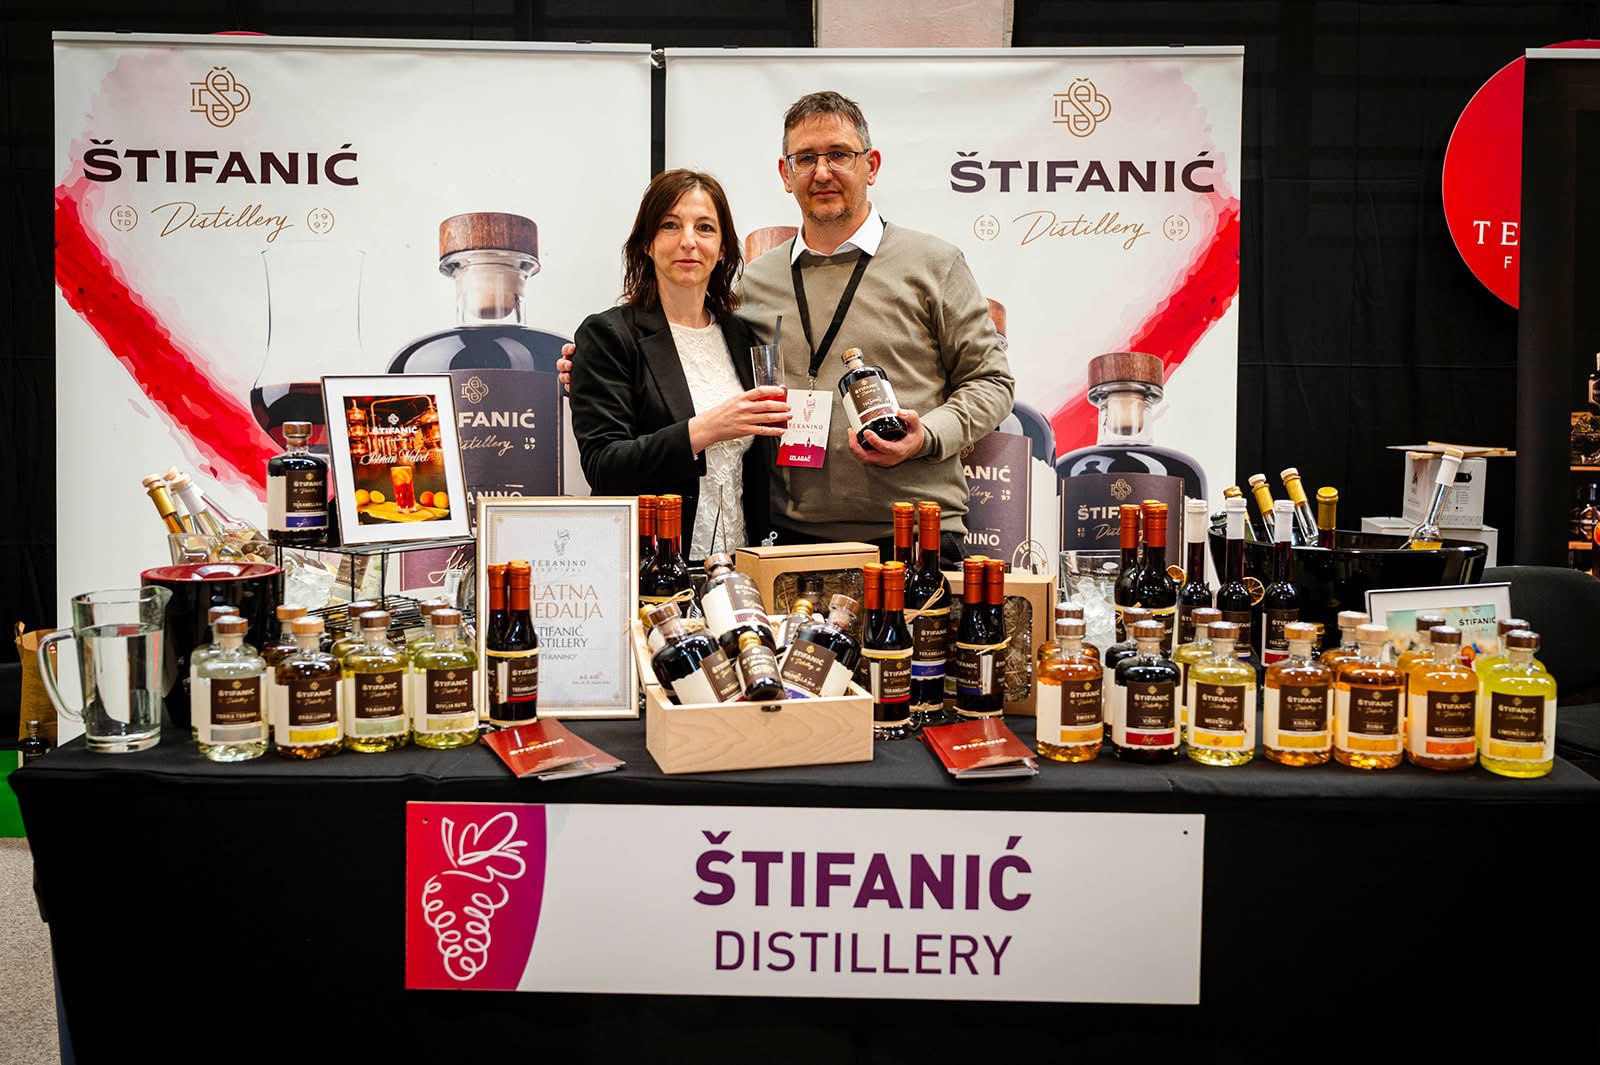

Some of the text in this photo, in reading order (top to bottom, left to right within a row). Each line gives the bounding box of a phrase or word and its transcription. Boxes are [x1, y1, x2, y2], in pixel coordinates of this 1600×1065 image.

[83, 138, 359, 186] ŠTIFANIĆ
[950, 151, 1215, 193] ŠTIFANIĆ
[151, 201, 295, 243] Distillery
[1012, 211, 1151, 250] Distillery
[1473, 220, 1518, 246] TE
[532, 584, 599, 601] LATNA
[693, 830, 1034, 912] ŠTIFANIĆ
[716, 931, 1013, 976] DISTILLERY
